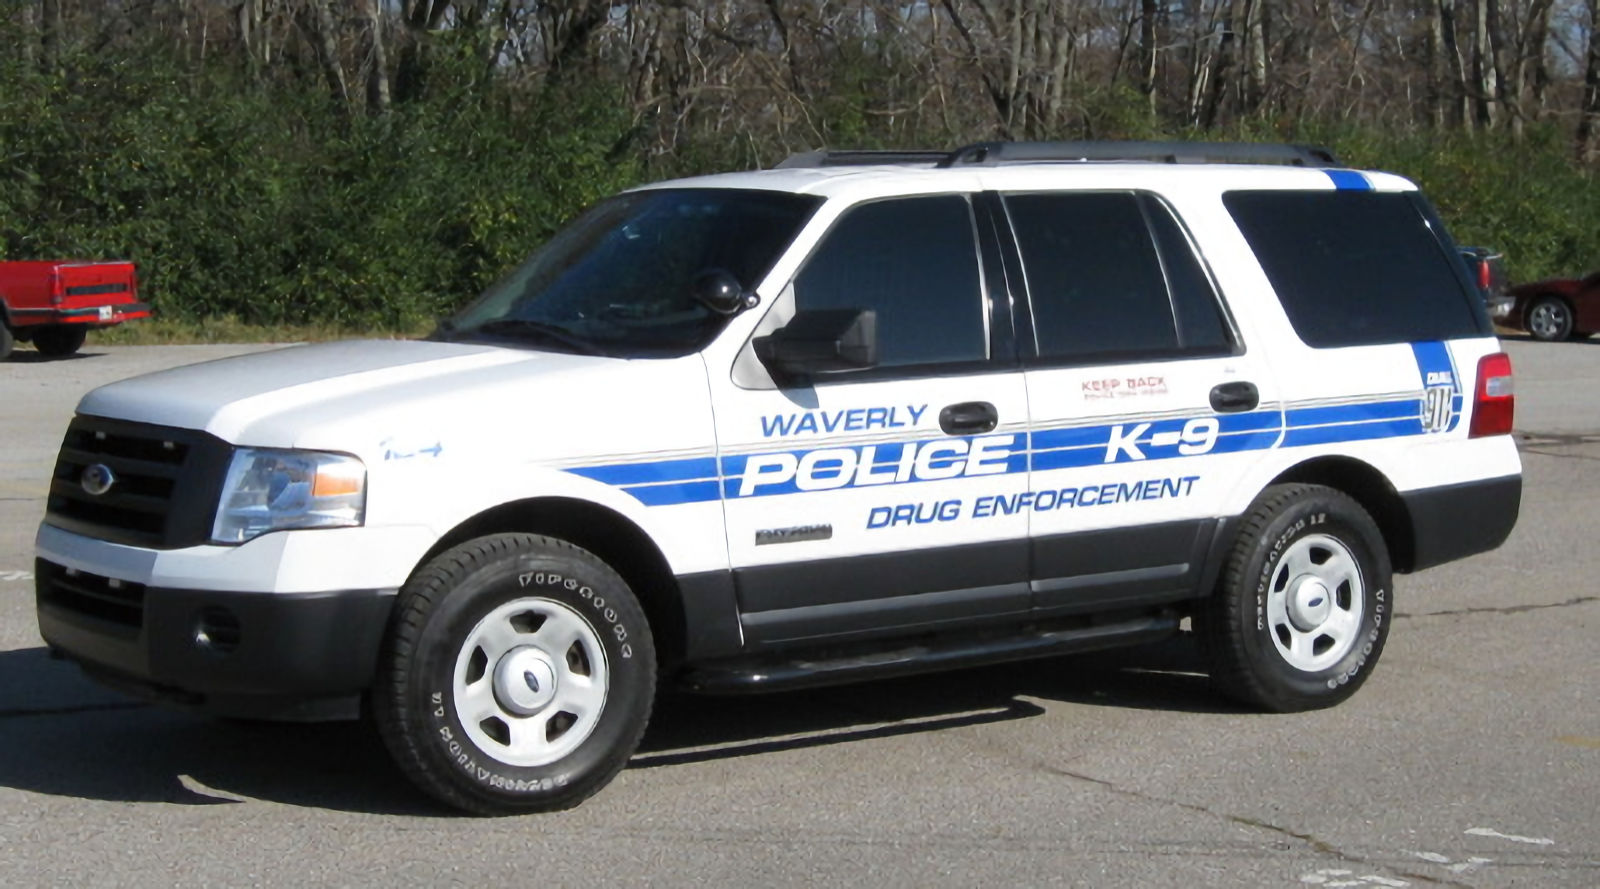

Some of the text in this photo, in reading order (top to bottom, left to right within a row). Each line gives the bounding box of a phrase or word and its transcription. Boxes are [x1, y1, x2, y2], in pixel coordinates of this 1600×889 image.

[761, 404, 928, 437] WAVERLY
[1103, 417, 1220, 463] K-9
[739, 435, 1014, 496] POLICE
[866, 476, 1200, 529] DRUG ENFORCEMENT
